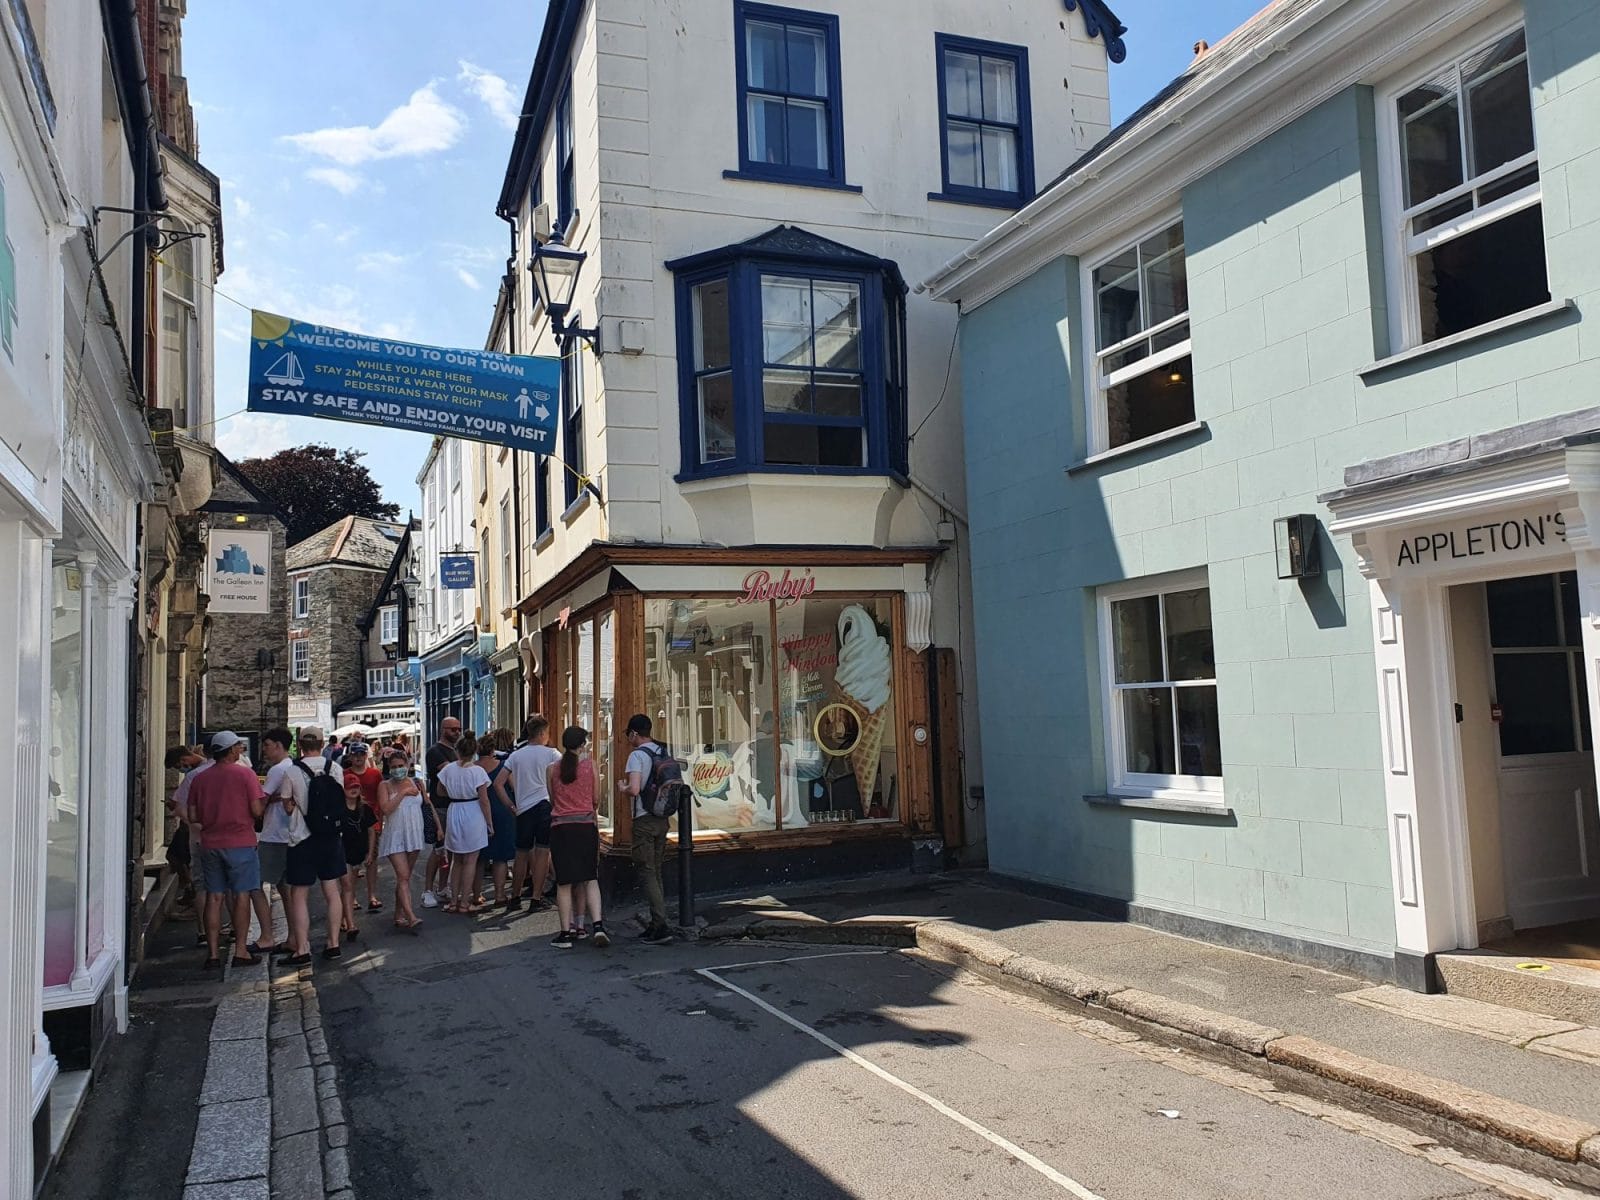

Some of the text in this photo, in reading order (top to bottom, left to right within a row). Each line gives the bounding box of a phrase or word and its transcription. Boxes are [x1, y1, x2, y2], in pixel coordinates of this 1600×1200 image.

[298, 333, 380, 353] WELCOME
[384, 343, 416, 358] YOU
[420, 348, 441, 361] TO
[445, 353, 476, 367] OUR
[481, 359, 524, 376] TOWN
[356, 359, 472, 384] WHILE YOU ARE HERE
[315, 364, 508, 402] STAY 2M APART & WEAR YOUR MASK
[344, 380, 483, 408] PEDESTRIANS STAY RIGHT
[262, 388, 547, 442] STAY SAFE AND ENJOY YOUR VISIT
[341, 409, 365, 418] THANK
[395, 416, 422, 426] KEEPING
[424, 421, 437, 429] OUR
[438, 423, 466, 433] FAMILIES
[466, 427, 482, 436] SAFE
[1397, 511, 1566, 567] APPLETON'S
[213, 577, 225, 585] The
[226, 577, 252, 585] Galleon
[736, 567, 816, 606] Ruby's
